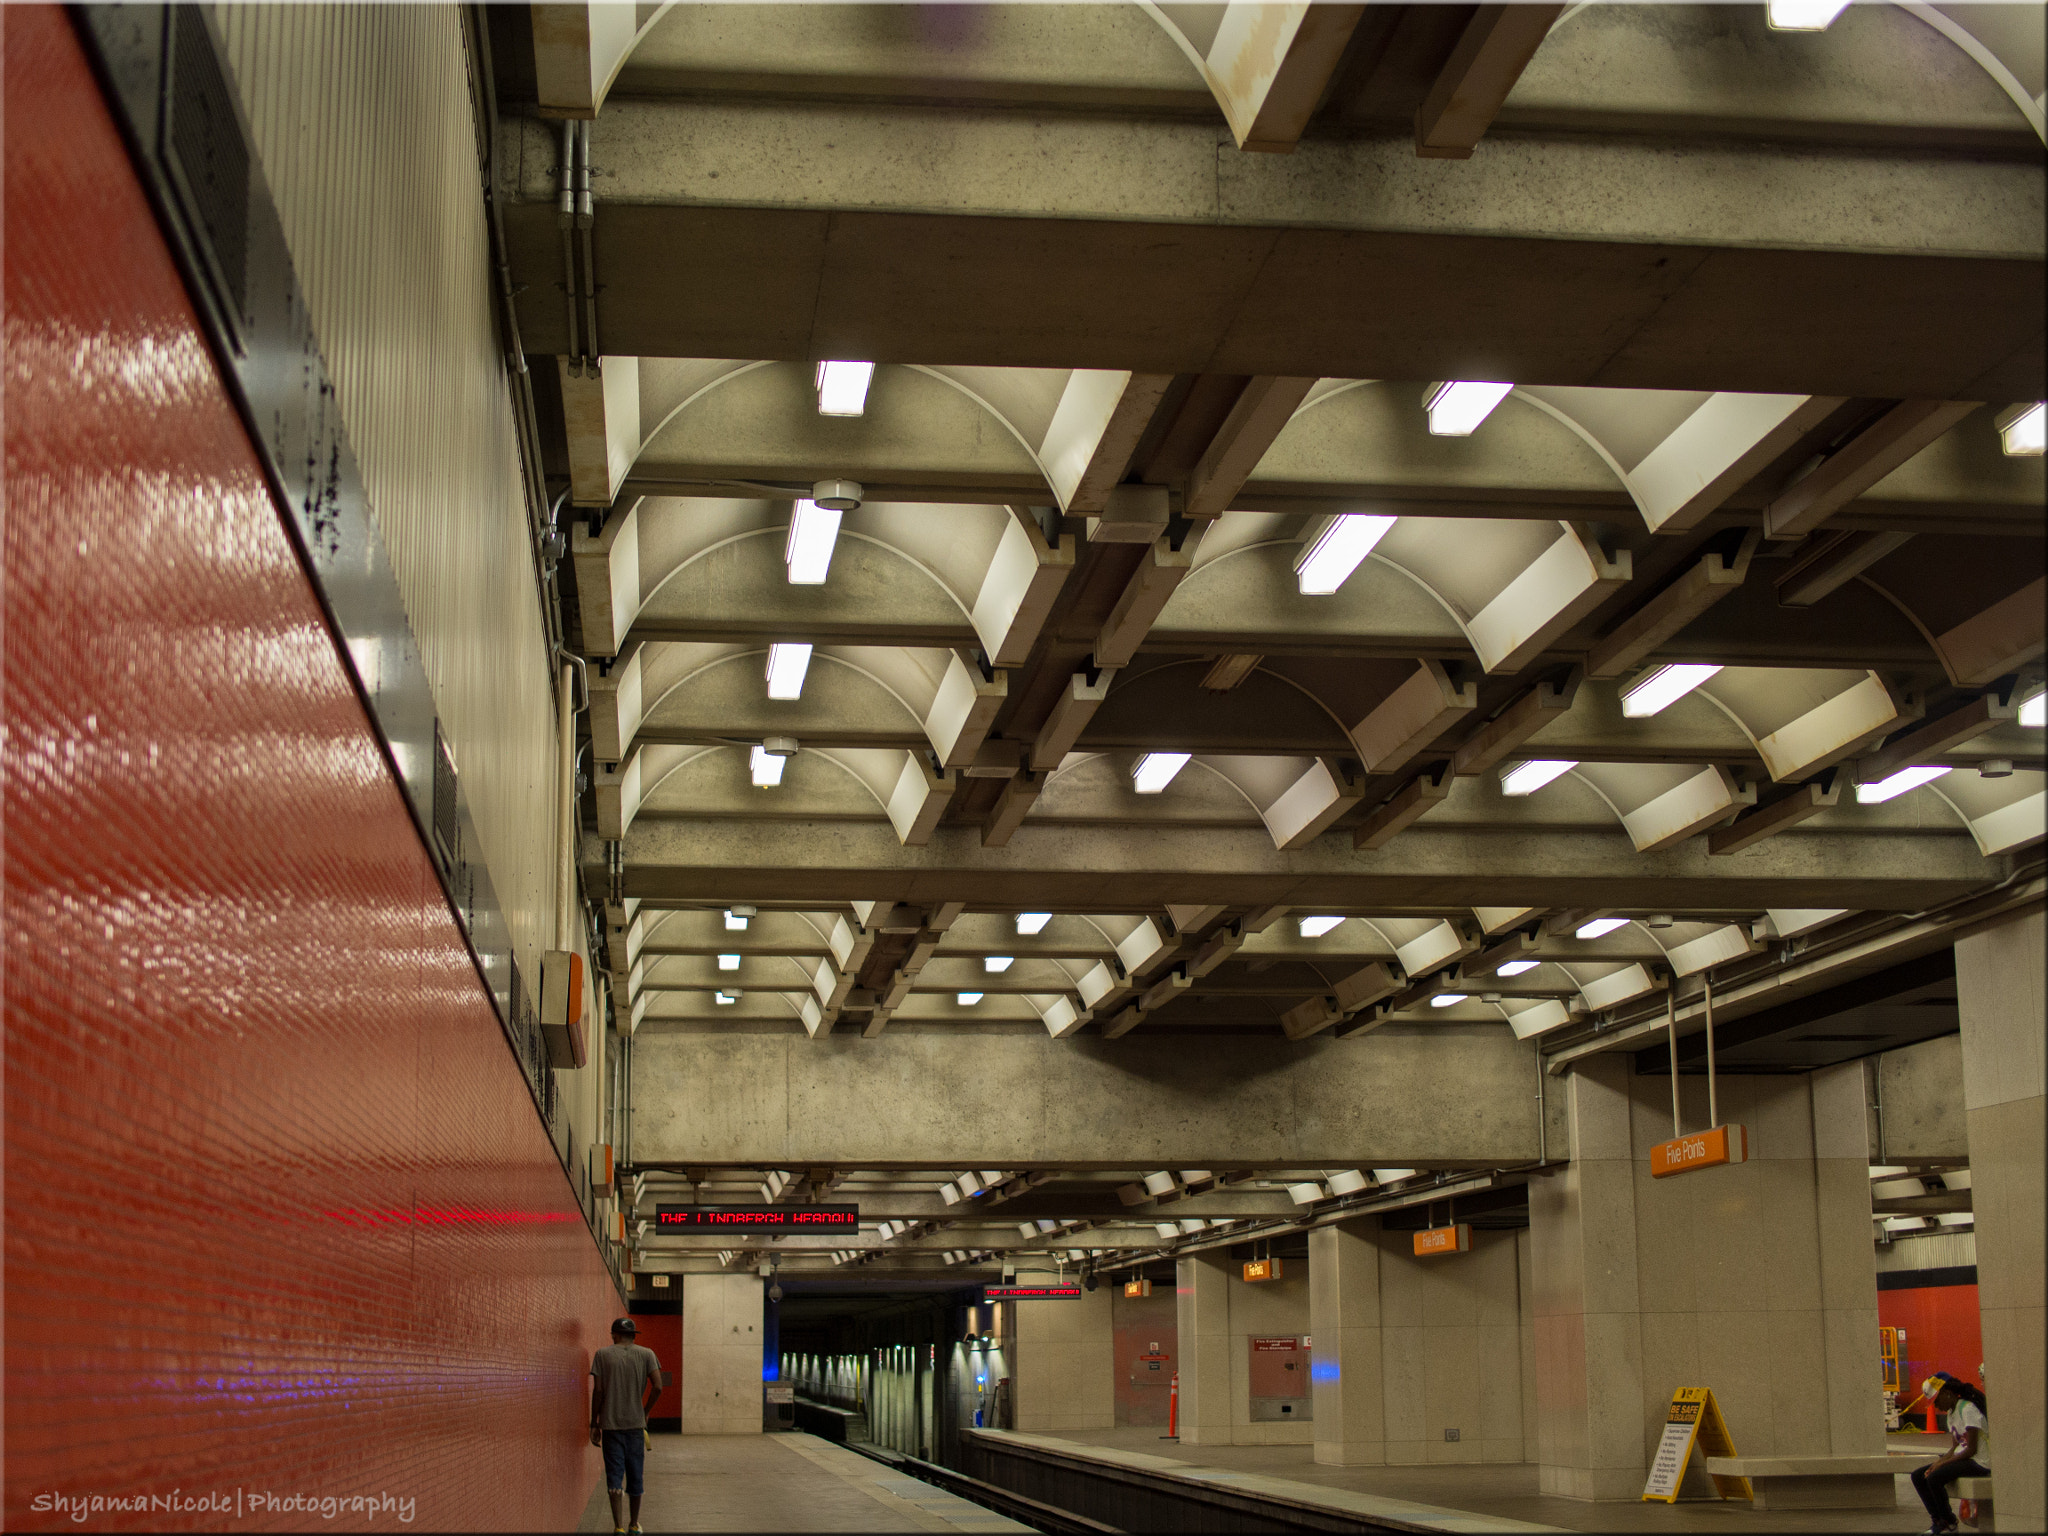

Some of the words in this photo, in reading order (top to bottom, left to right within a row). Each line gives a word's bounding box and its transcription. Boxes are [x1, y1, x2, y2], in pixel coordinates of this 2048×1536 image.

[1666, 1144, 1682, 1165] Five
[1682, 1138, 1706, 1161] Points
[1422, 1233, 1432, 1249] Five
[1432, 1231, 1446, 1247] Points
[1670, 1405, 1682, 1414] BE
[1681, 1405, 1699, 1414] SAFE
